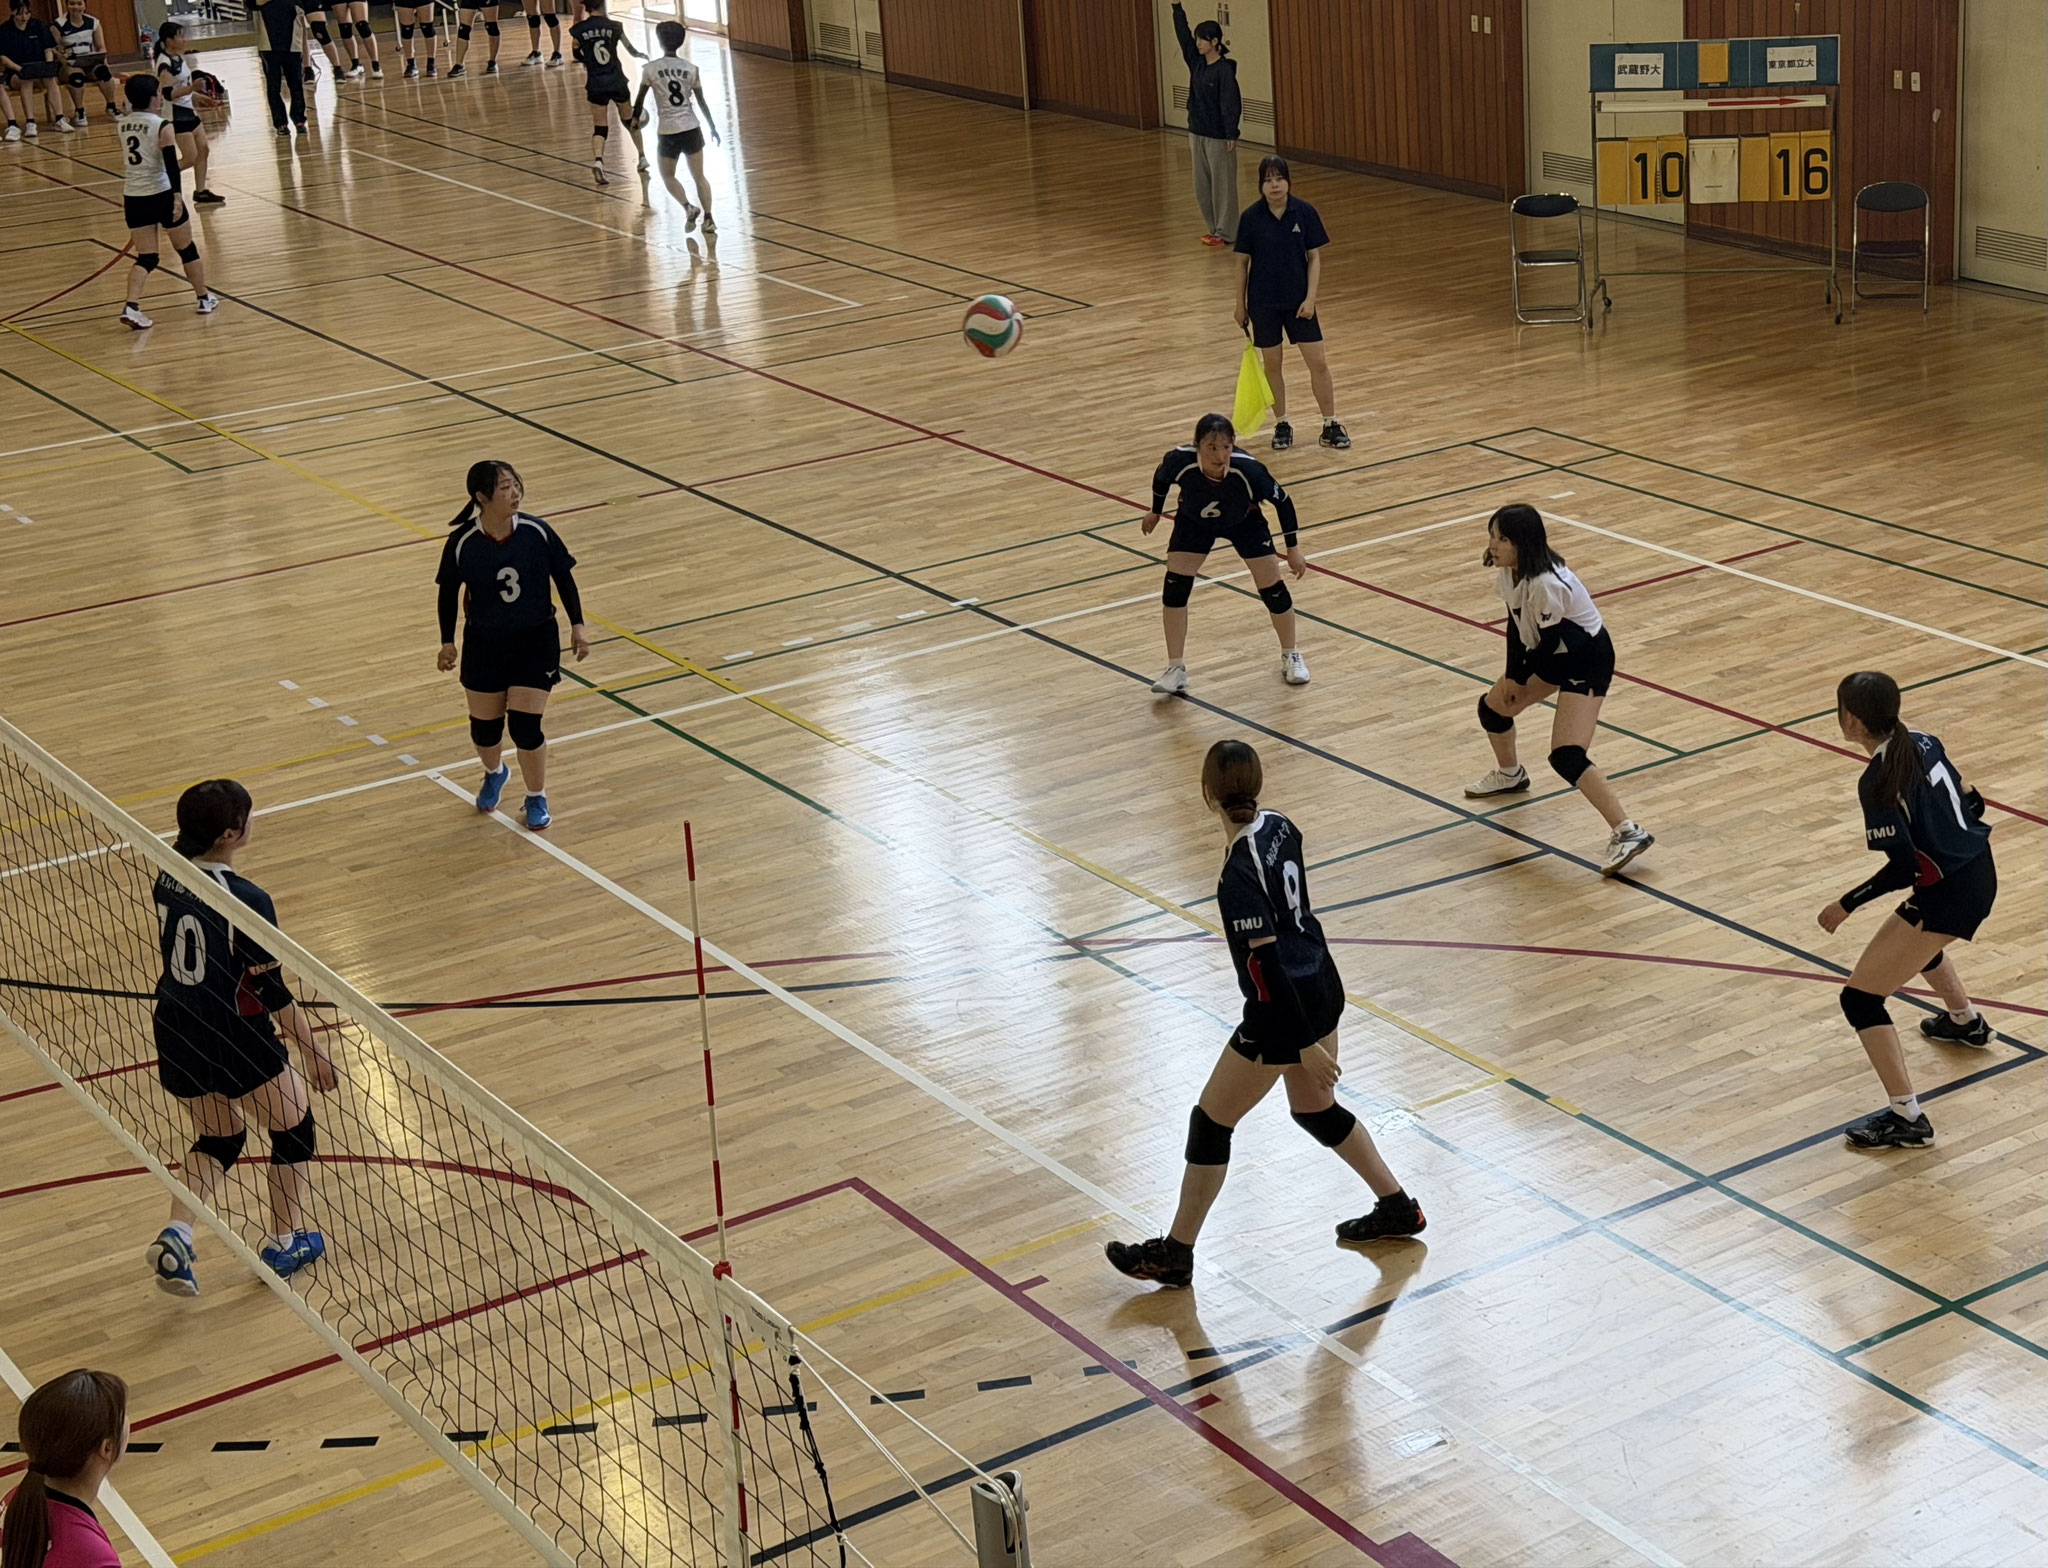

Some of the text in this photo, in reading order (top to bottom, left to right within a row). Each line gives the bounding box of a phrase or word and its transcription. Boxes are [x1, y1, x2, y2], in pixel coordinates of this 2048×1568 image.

[593, 40, 611, 65] 6
[1768, 58, 1815, 69] 東京都立大
[1617, 64, 1661, 75] 武蔵野大
[668, 80, 685, 107] 8
[126, 136, 142, 165] 3
[1633, 152, 1684, 200] 10
[1776, 148, 1829, 196] 16
[1200, 501, 1221, 518] 6
[496, 566, 521, 603] 3
[1866, 824, 1896, 841] TMU
[1232, 916, 1263, 932] TMU
